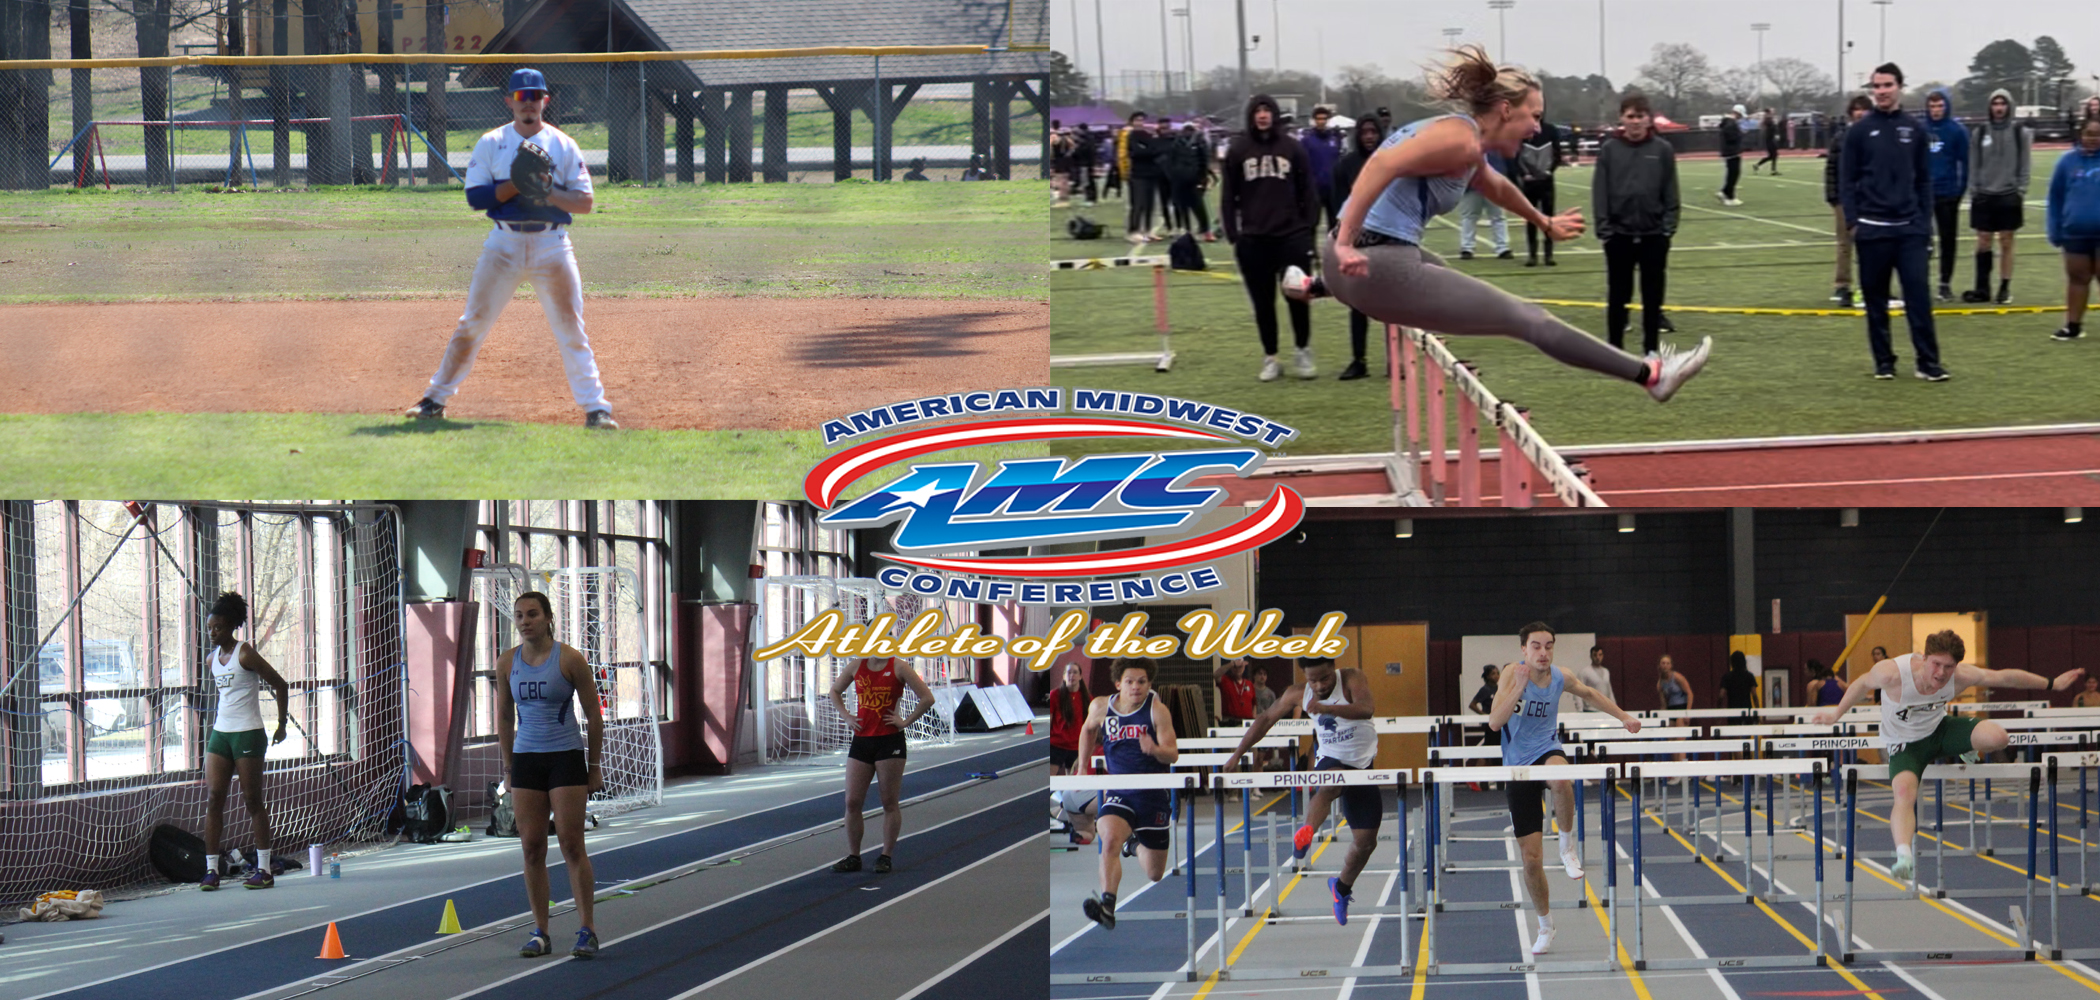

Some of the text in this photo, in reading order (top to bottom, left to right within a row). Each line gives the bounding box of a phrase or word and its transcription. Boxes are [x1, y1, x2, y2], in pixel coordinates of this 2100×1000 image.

[1243, 155, 1291, 181] GAP
[519, 681, 548, 700] CBC
[1527, 700, 1550, 718] CBC
[1896, 708, 1909, 722] 4
[1109, 717, 1119, 735] 8
[1322, 732, 1354, 745] SPARTANS
[1812, 738, 1869, 749] PRINCIPIA
[2009, 734, 2038, 744] CIPIA
[1274, 773, 1346, 786] PRINCIPIA
[1301, 969, 1327, 977] UCS
[1509, 964, 1536, 972] UCS
[1087, 975, 1112, 983] UCS
